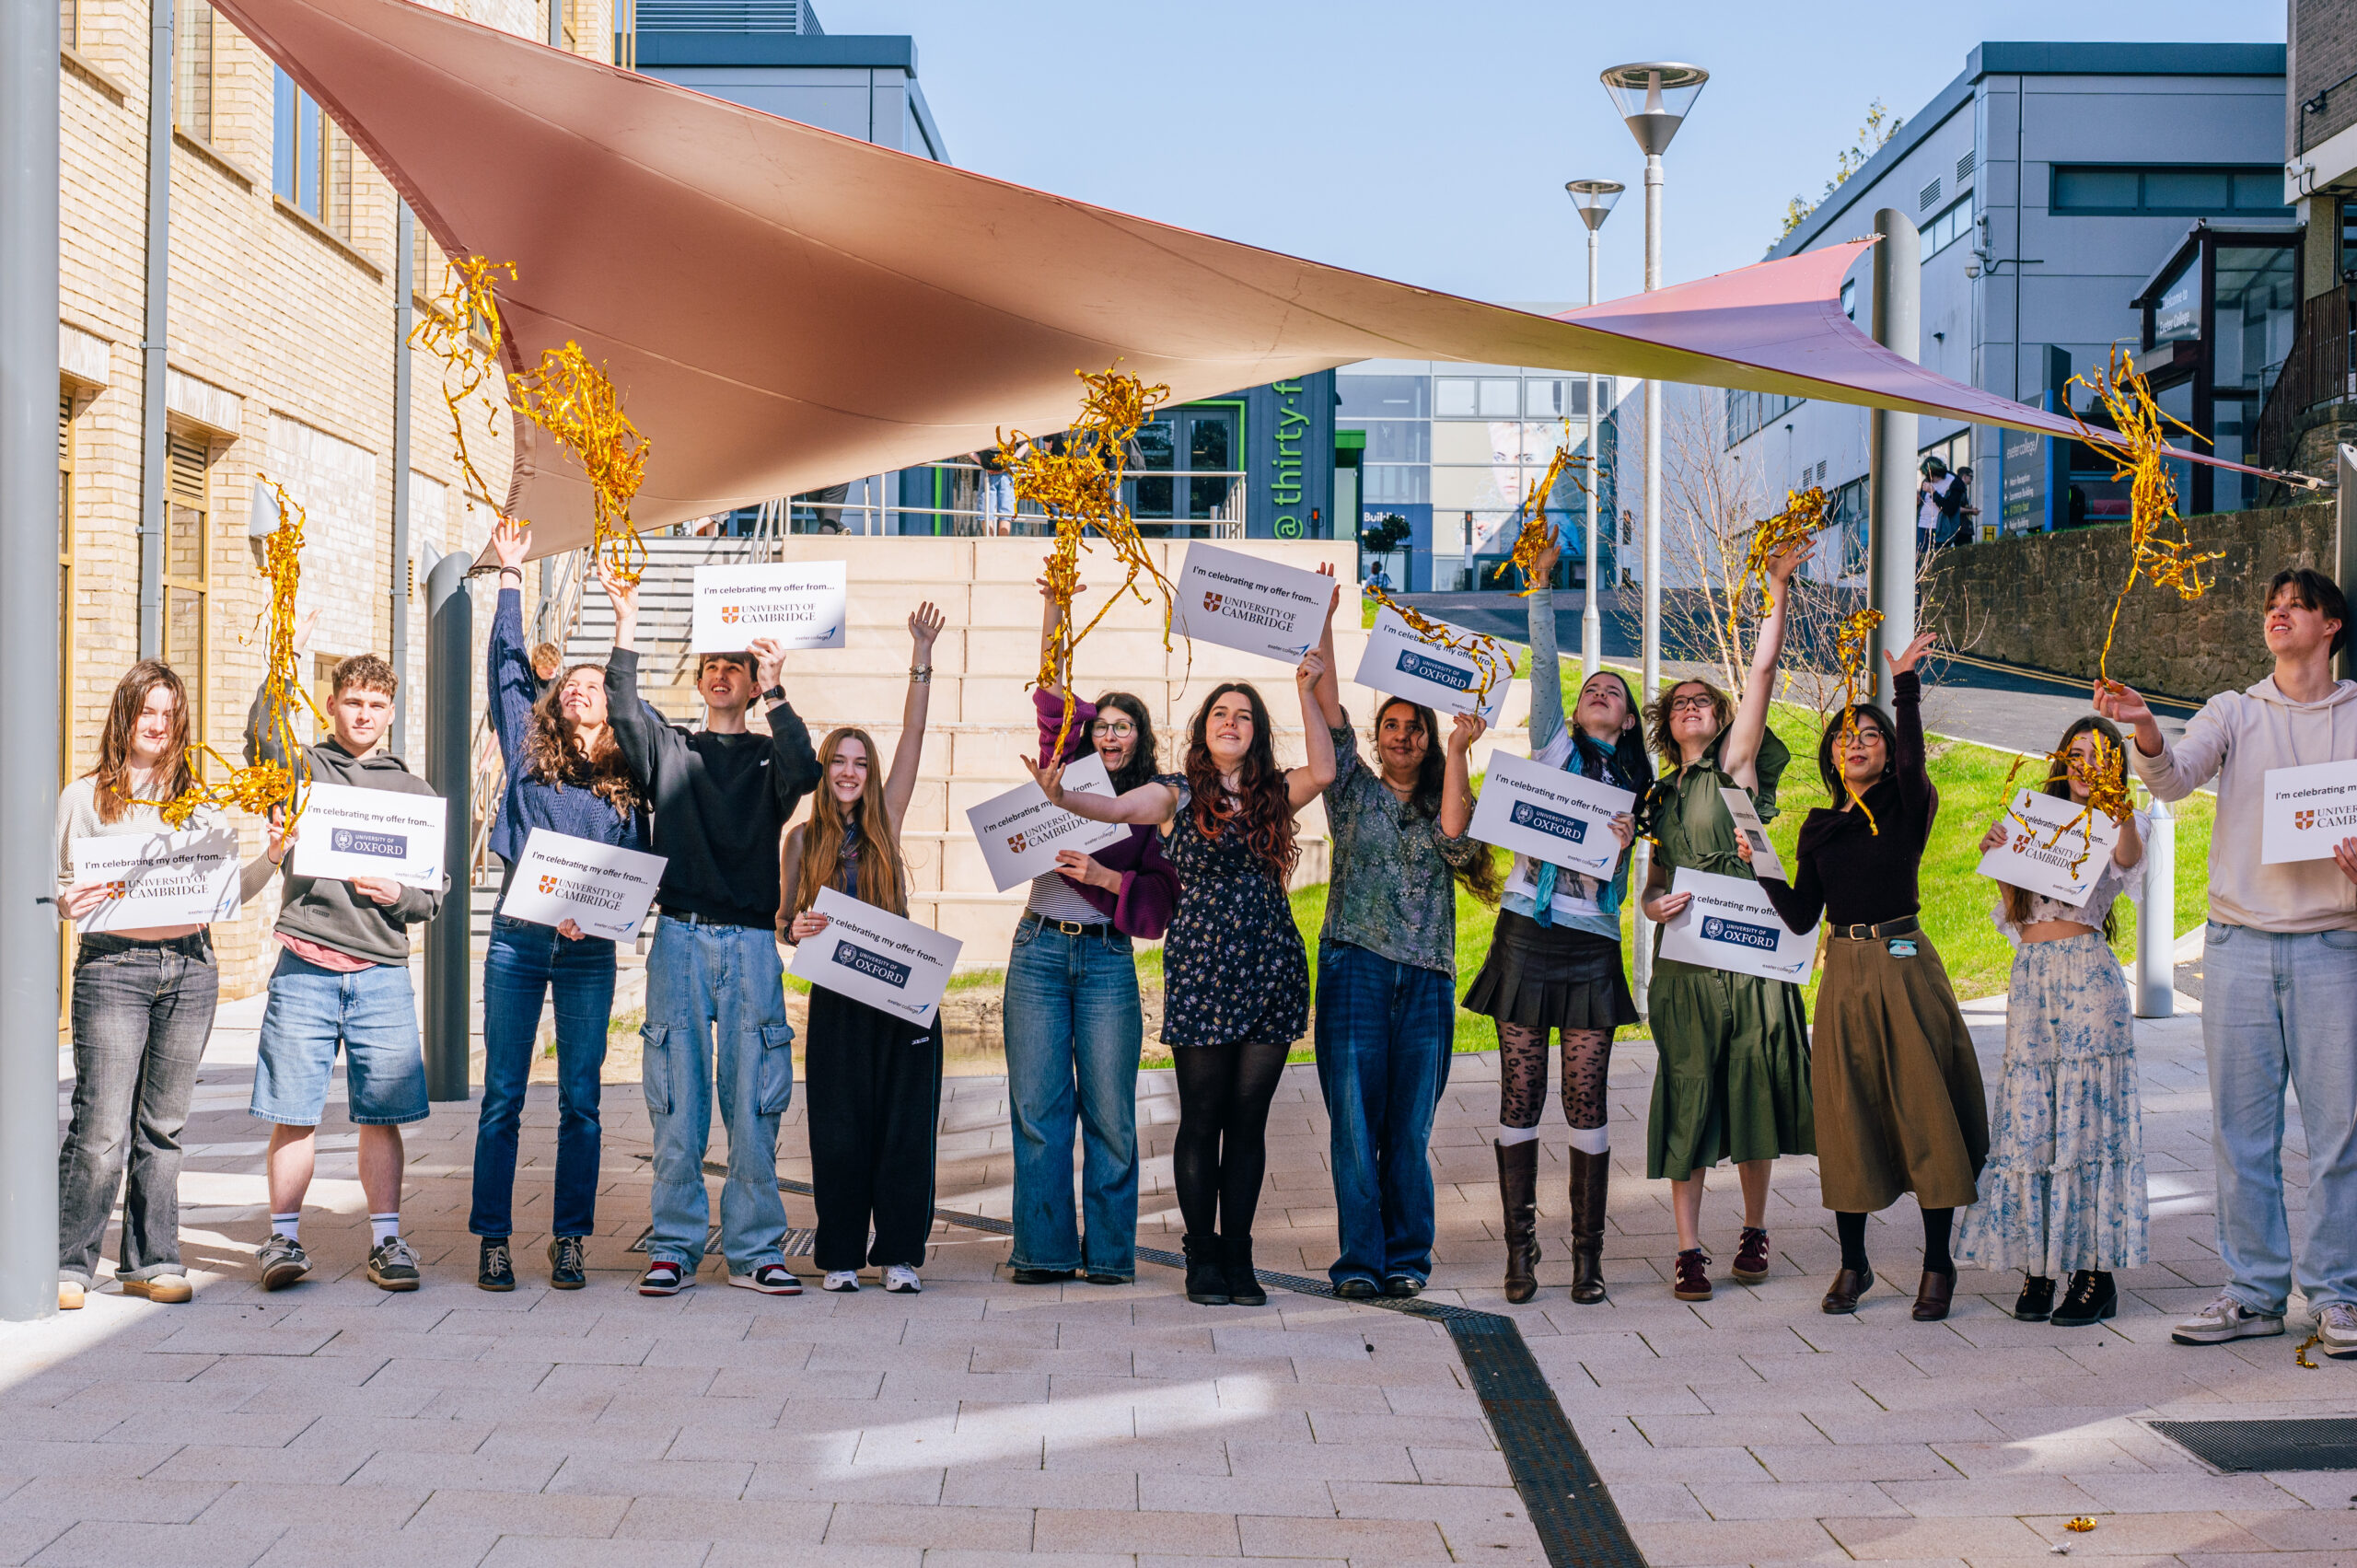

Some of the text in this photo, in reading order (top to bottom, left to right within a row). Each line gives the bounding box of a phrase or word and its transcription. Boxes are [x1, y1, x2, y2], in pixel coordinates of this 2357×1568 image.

[2160, 319, 2173, 335] Exeter
[2174, 311, 2189, 328] College
[2007, 437, 2035, 459] exeter college
[1985, 527, 1994, 540] H
[704, 583, 835, 595] I'm celebrating my offer from...
[1193, 565, 1318, 606] I'm celebrating my offer from...
[742, 602, 816, 613] UNIVERSITY OF
[1225, 596, 1297, 621] UNIVERSITY OF
[742, 612, 817, 623] CAMBRIDGE
[1222, 606, 1295, 633] CAMBRIDGE
[1267, 644, 1299, 656] exeter college
[1384, 624, 1397, 634] I'm
[1444, 646, 1457, 656] my
[1457, 650, 1476, 660] offe
[1422, 660, 1452, 674] UNIVERSITY
[1419, 667, 1466, 689] OXFORD
[1496, 773, 1509, 784] I'm
[1510, 781, 1555, 801] celebrating
[1556, 794, 1569, 805] my
[1571, 798, 1590, 810] offer
[2276, 792, 2290, 800] I'm
[2293, 785, 2345, 797] celebrating
[308, 805, 320, 814] I'm
[323, 807, 369, 821] celebrating
[386, 816, 405, 824] offer
[408, 818, 435, 828] from...
[983, 823, 997, 833] I'm
[998, 805, 1040, 827] celebrating
[1040, 800, 1052, 809] my
[1025, 812, 1077, 838] UNIVERSIT
[1537, 810, 1566, 825] UNIVERSITY
[1028, 817, 1092, 847] CAMBRIDG
[1533, 818, 1581, 840] OXFORD
[2026, 816, 2060, 831] celebrating
[2071, 829, 2084, 838] offe
[355, 834, 386, 842] UNIVERSITY
[354, 842, 403, 855] OXFORD
[102, 857, 154, 868] celebrating
[157, 857, 169, 865] my
[172, 854, 193, 864] offer
[196, 853, 227, 862] from...
[532, 851, 648, 885] I'm celebrating my offer from...
[1582, 858, 1598, 868] college
[128, 875, 209, 889] UNIVERSITY OF
[558, 878, 626, 901] UNIVERSITY OF
[129, 884, 209, 900] CAMBRIDGE
[555, 888, 622, 912] CAMBRIDGE
[1698, 896, 1744, 912] celebrating
[1746, 906, 1759, 916] my
[1760, 908, 1779, 916] offe
[608, 924, 624, 933] college
[1727, 923, 1758, 934] UNIVERSITY
[835, 918, 881, 942] celebrating
[881, 935, 894, 947] my
[896, 942, 915, 956] offer
[916, 949, 944, 967] from...
[1724, 930, 1774, 948] OXFORD
[859, 952, 889, 967] UNIVERSITY
[1777, 965, 1795, 973] college
[855, 958, 904, 984] OXFORD
[887, 998, 919, 1014] exeter college
